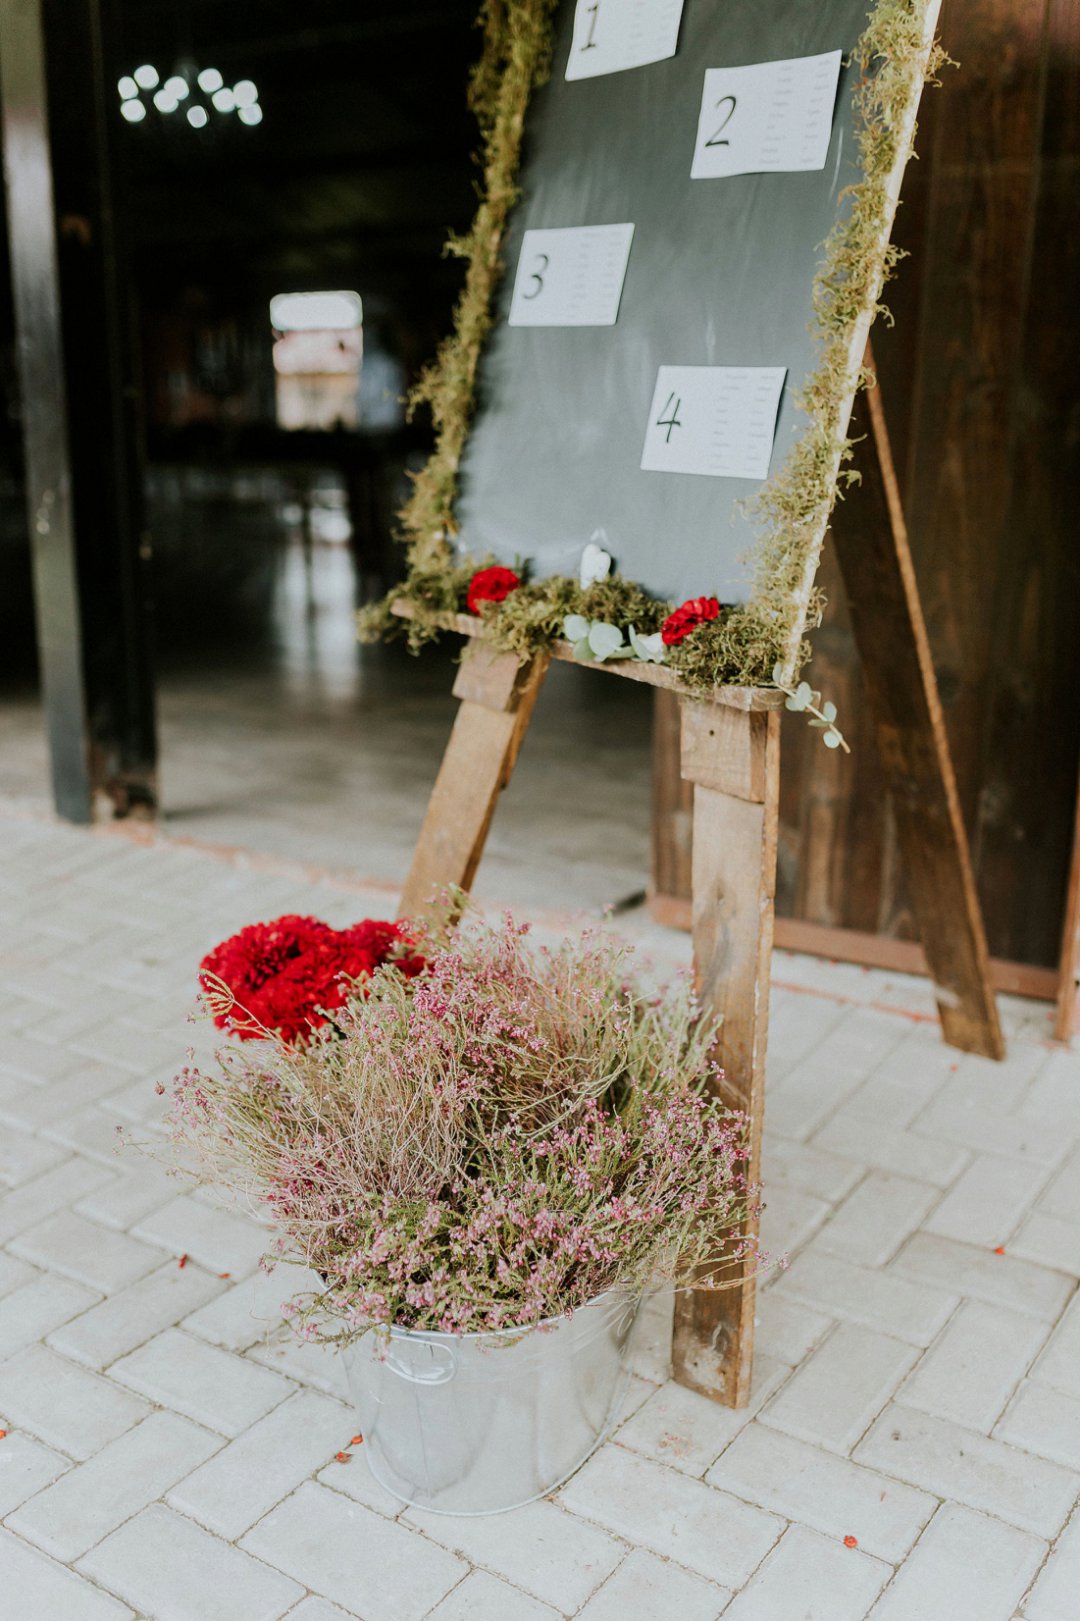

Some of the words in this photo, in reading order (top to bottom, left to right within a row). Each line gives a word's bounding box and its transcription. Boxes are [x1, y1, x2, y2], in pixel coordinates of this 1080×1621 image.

[580, 1, 599, 52] 1
[705, 95, 737, 148] 2
[523, 253, 550, 300] 3
[656, 391, 681, 444] 4
